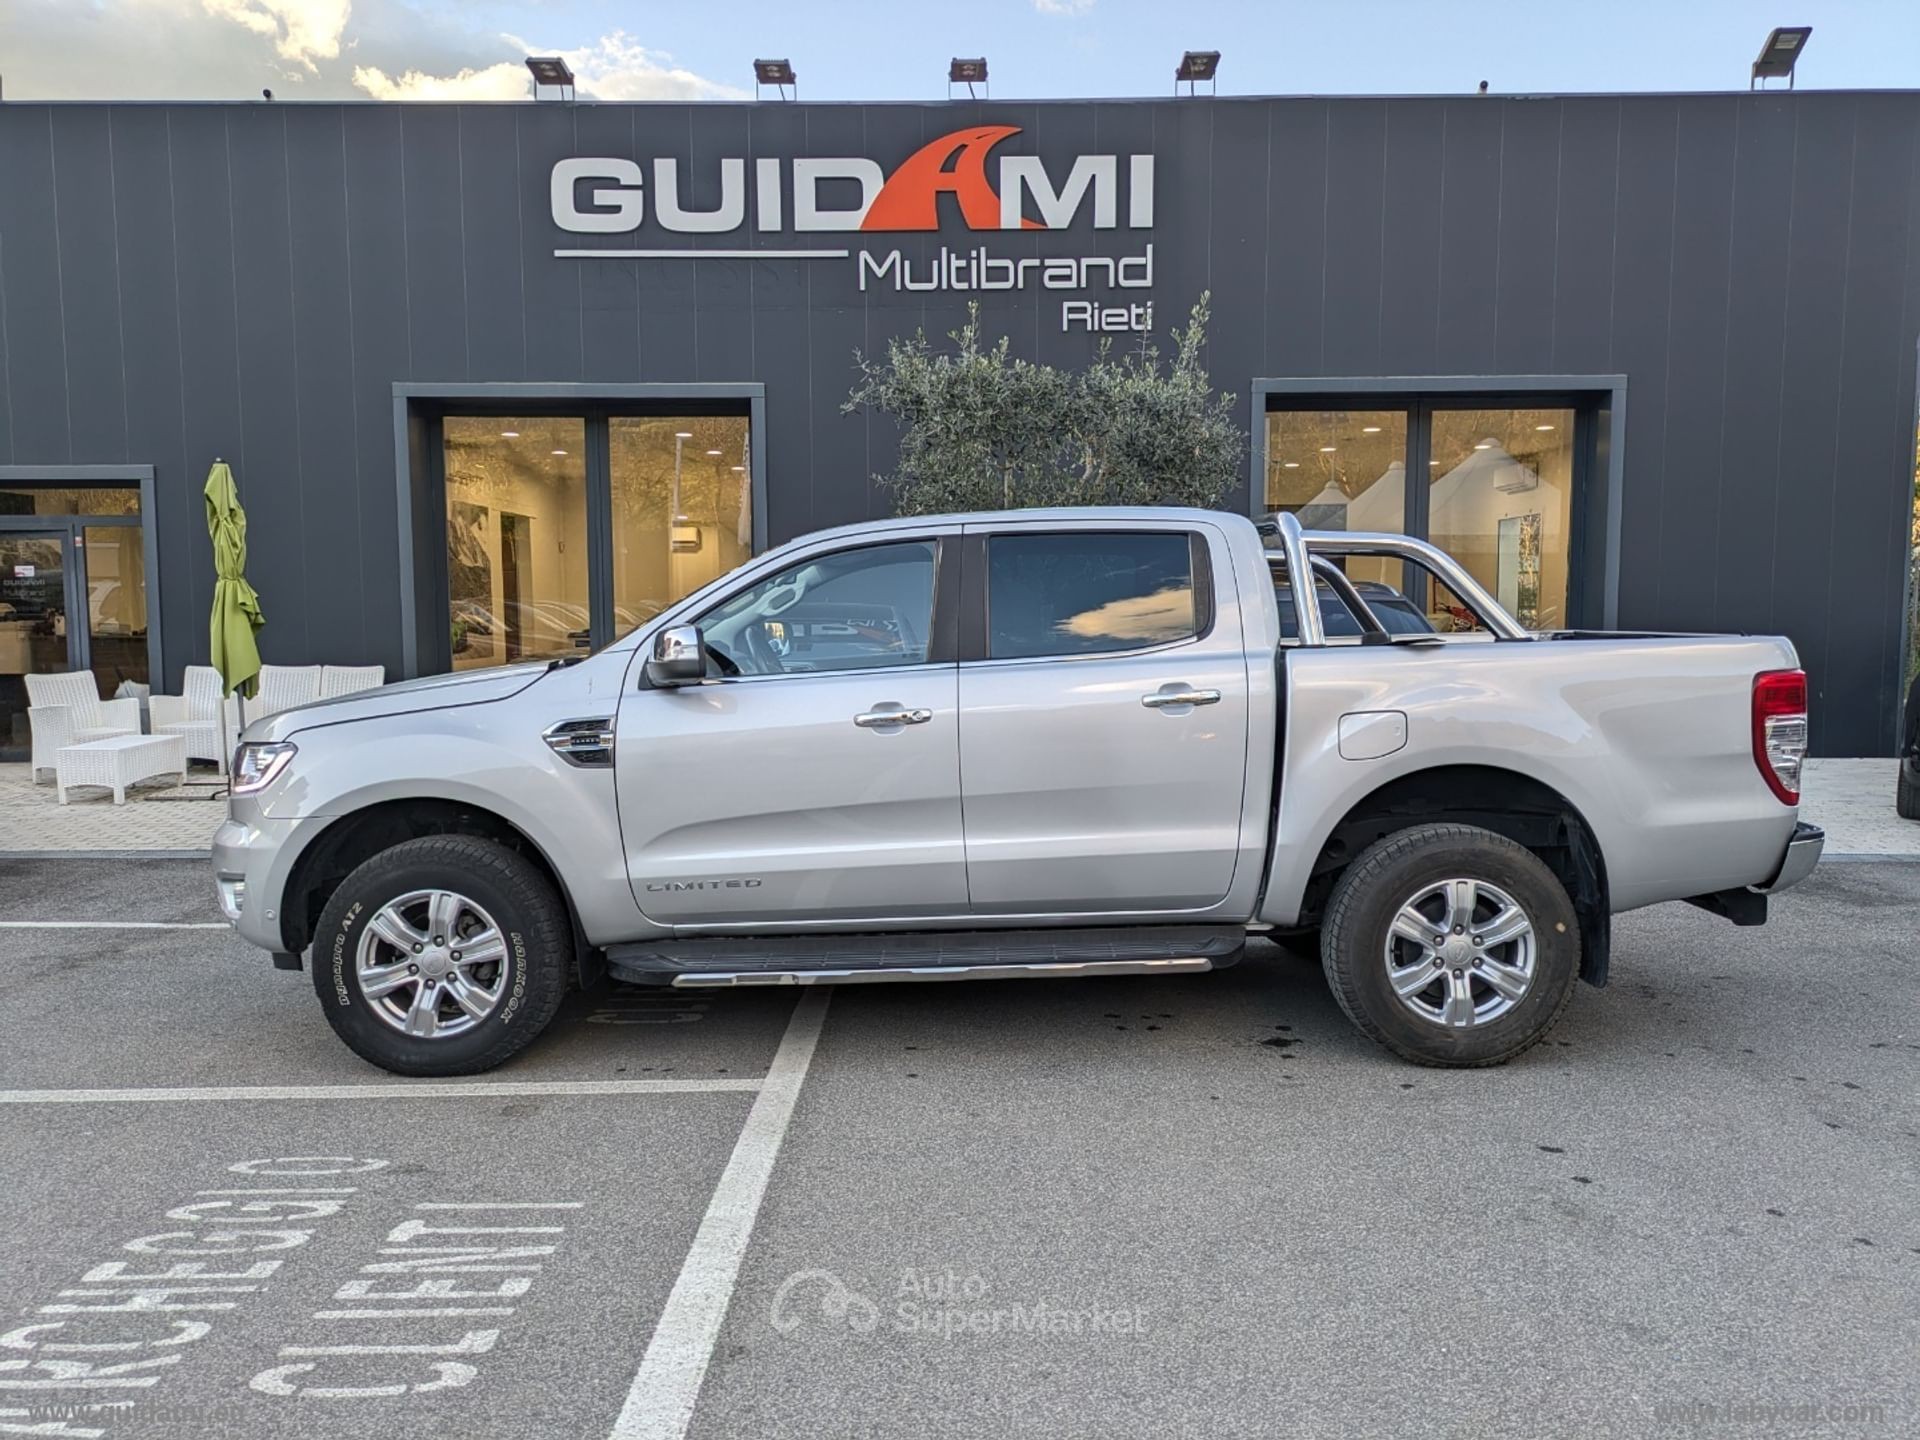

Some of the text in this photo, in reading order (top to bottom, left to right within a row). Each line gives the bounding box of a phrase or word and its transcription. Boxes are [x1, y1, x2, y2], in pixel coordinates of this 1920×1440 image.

[549, 125, 1154, 232] GUIDAMI
[858, 244, 1153, 291] Multibrand
[1062, 301, 1153, 332] Rieti
[646, 878, 762, 892] LIMITED
[0, 1156, 391, 1438] ARCHEGGIO
[249, 1201, 584, 1398] CLIENTI
